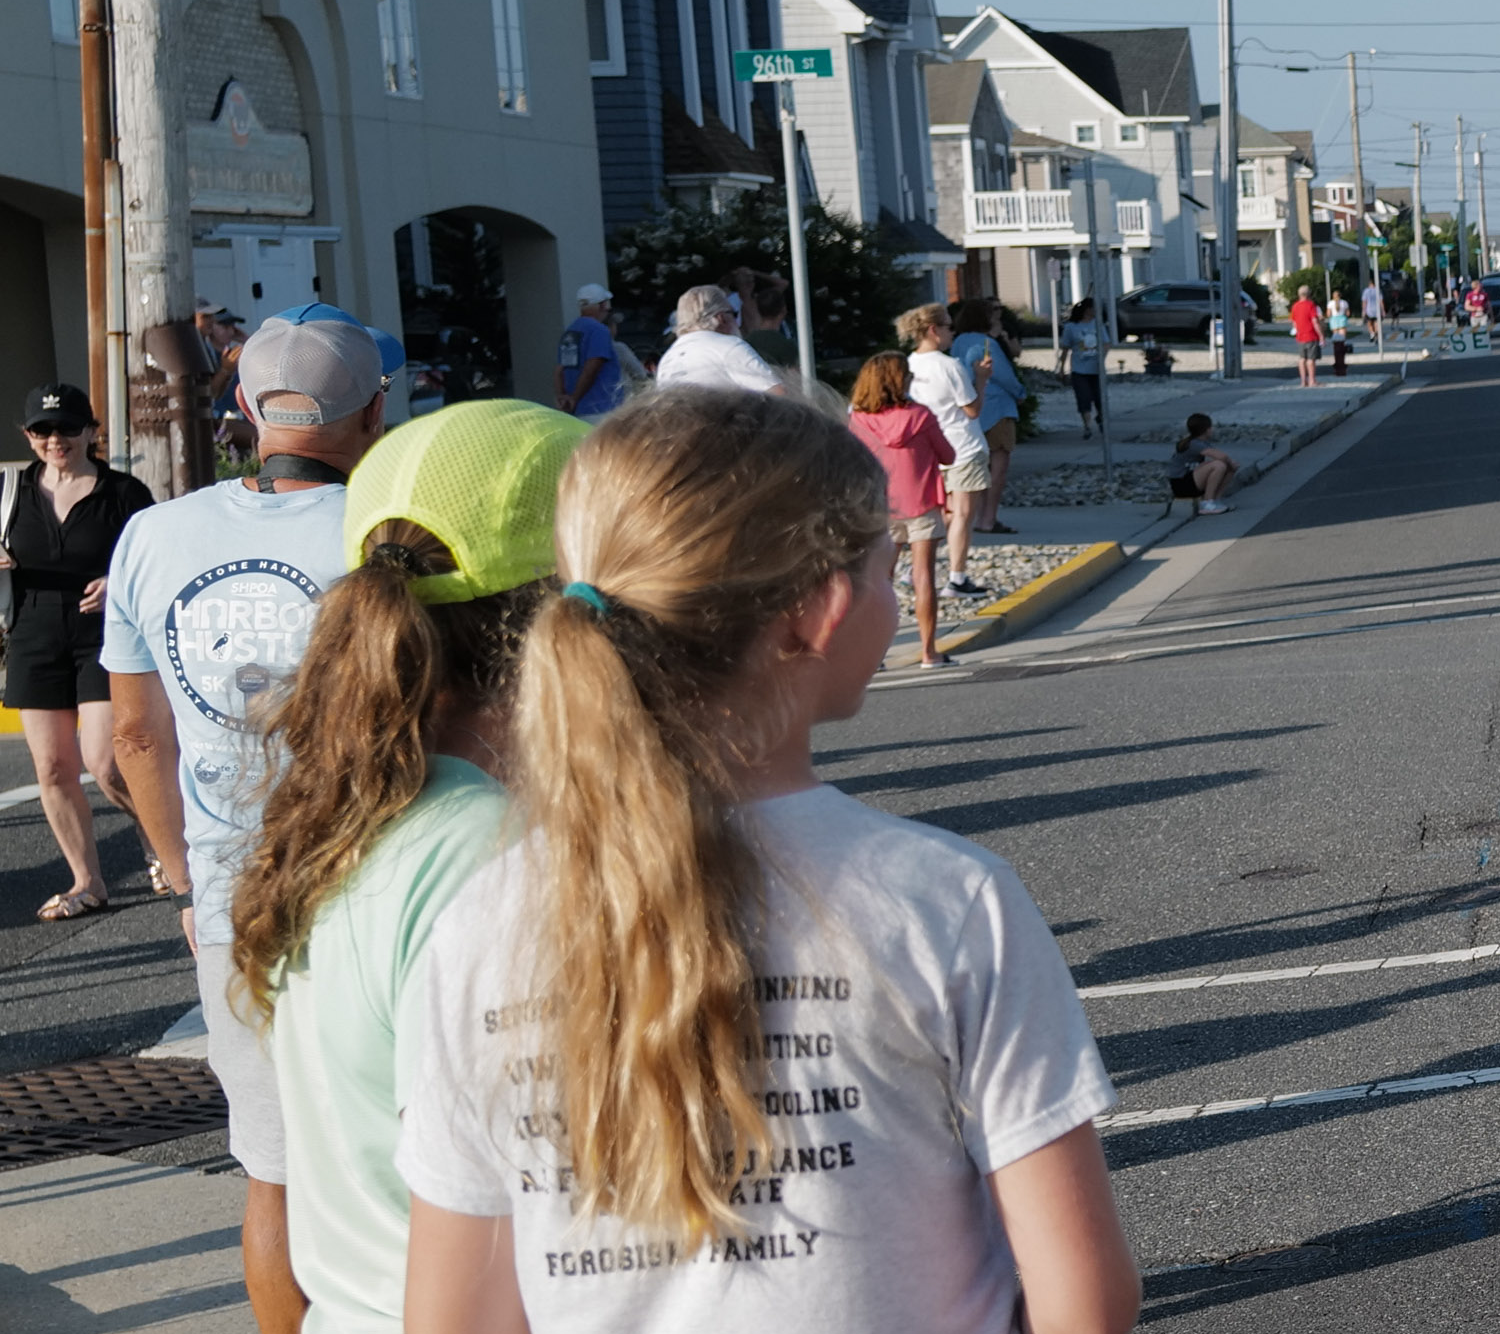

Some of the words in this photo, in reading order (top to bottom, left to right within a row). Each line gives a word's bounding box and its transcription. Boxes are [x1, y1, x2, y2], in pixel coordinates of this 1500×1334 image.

[753, 54, 796, 76] 96th
[802, 57, 815, 70] ST
[195, 561, 249, 587] STONE
[259, 561, 317, 594] HARBOR
[231, 582, 277, 595] SHPOA
[177, 629, 310, 663] HUSTL
[168, 629, 202, 704] PROPERTY
[201, 675, 227, 693] 5K
